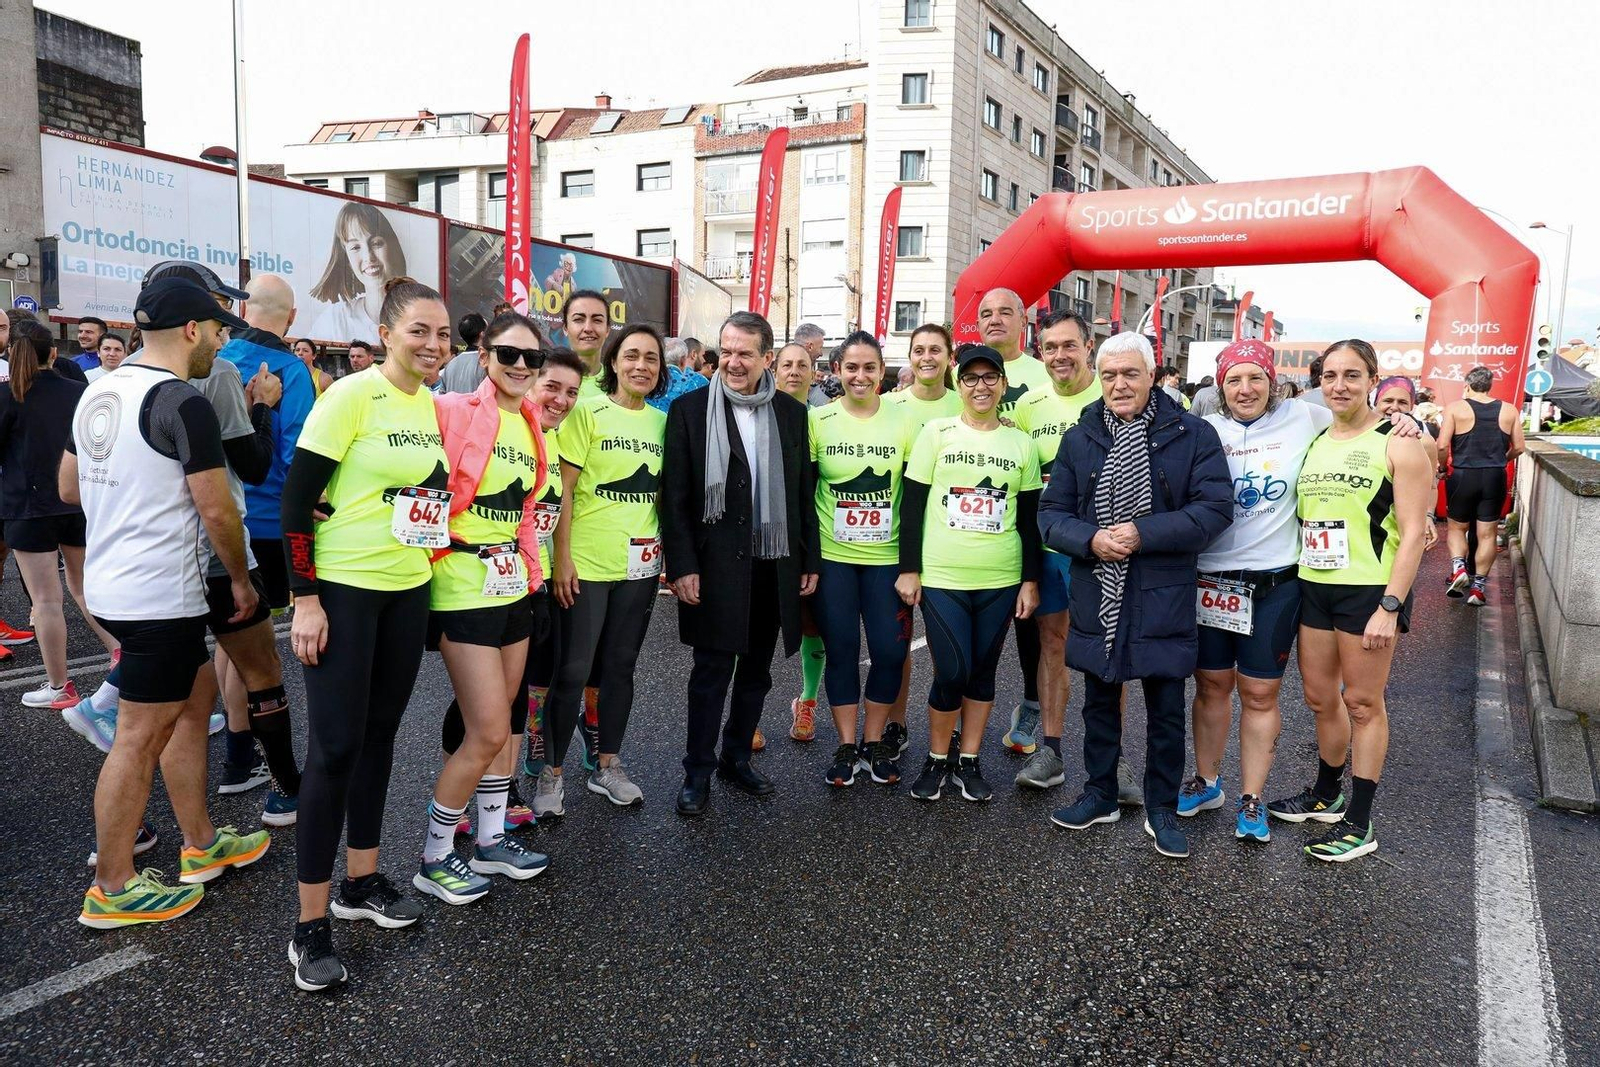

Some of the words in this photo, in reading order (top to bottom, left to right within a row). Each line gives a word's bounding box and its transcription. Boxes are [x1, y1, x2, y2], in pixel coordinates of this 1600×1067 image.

[77, 155, 175, 188] HERNÁNDEZ
[78, 172, 122, 194] LIMIA
[1201, 194, 1353, 223] Santander
[1080, 205, 1158, 233] Sports
[62, 221, 199, 261] Ortodoncia
[206, 243, 293, 274] invsible
[1158, 232, 1248, 246] sportssantander.es
[62, 254, 88, 274] La
[95, 259, 146, 284] mejo
[19, 302, 34, 311] ADT
[85, 302, 119, 313] Avenida
[121, 304, 134, 314] Ra
[1451, 320, 1500, 336] Sports
[1444, 343, 1519, 355] Santander
[1032, 423, 1057, 440] máis
[601, 436, 631, 451] máis
[826, 442, 855, 456] máis
[856, 443, 865, 458] que
[867, 445, 896, 459] auga
[1231, 446, 1259, 457] ribera
[945, 450, 975, 464] máis
[988, 456, 1016, 471] auga
[595, 488, 658, 503] RUNNIN
[409, 500, 441, 525] 642
[960, 496, 993, 515] 621
[846, 510, 881, 526] 678
[1304, 530, 1329, 549] 641
[1201, 590, 1240, 613] 648
